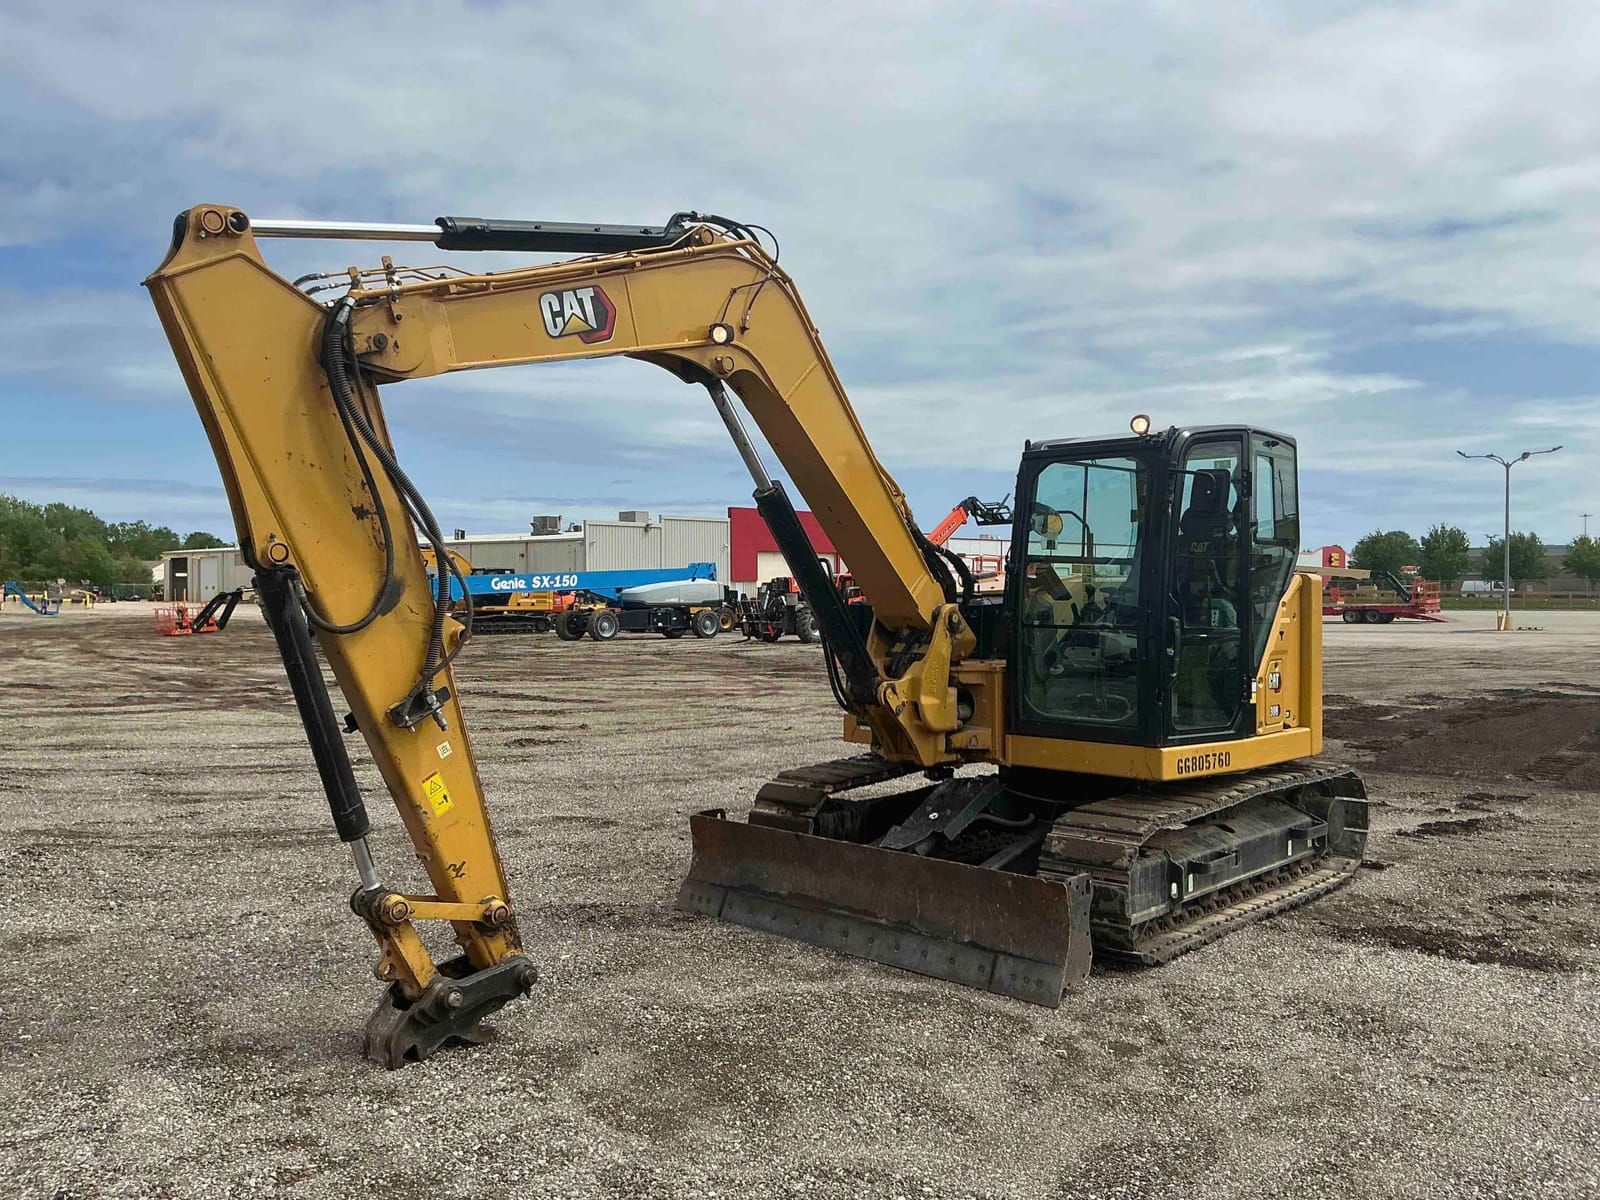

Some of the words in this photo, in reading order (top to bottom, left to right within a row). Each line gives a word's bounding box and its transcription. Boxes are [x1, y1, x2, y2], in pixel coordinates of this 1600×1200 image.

[540, 287, 597, 337] CAT
[491, 577, 527, 590] Genie
[532, 575, 577, 588] SX-150
[1269, 672, 1279, 689] CAT
[1177, 751, 1231, 775] GG805760
